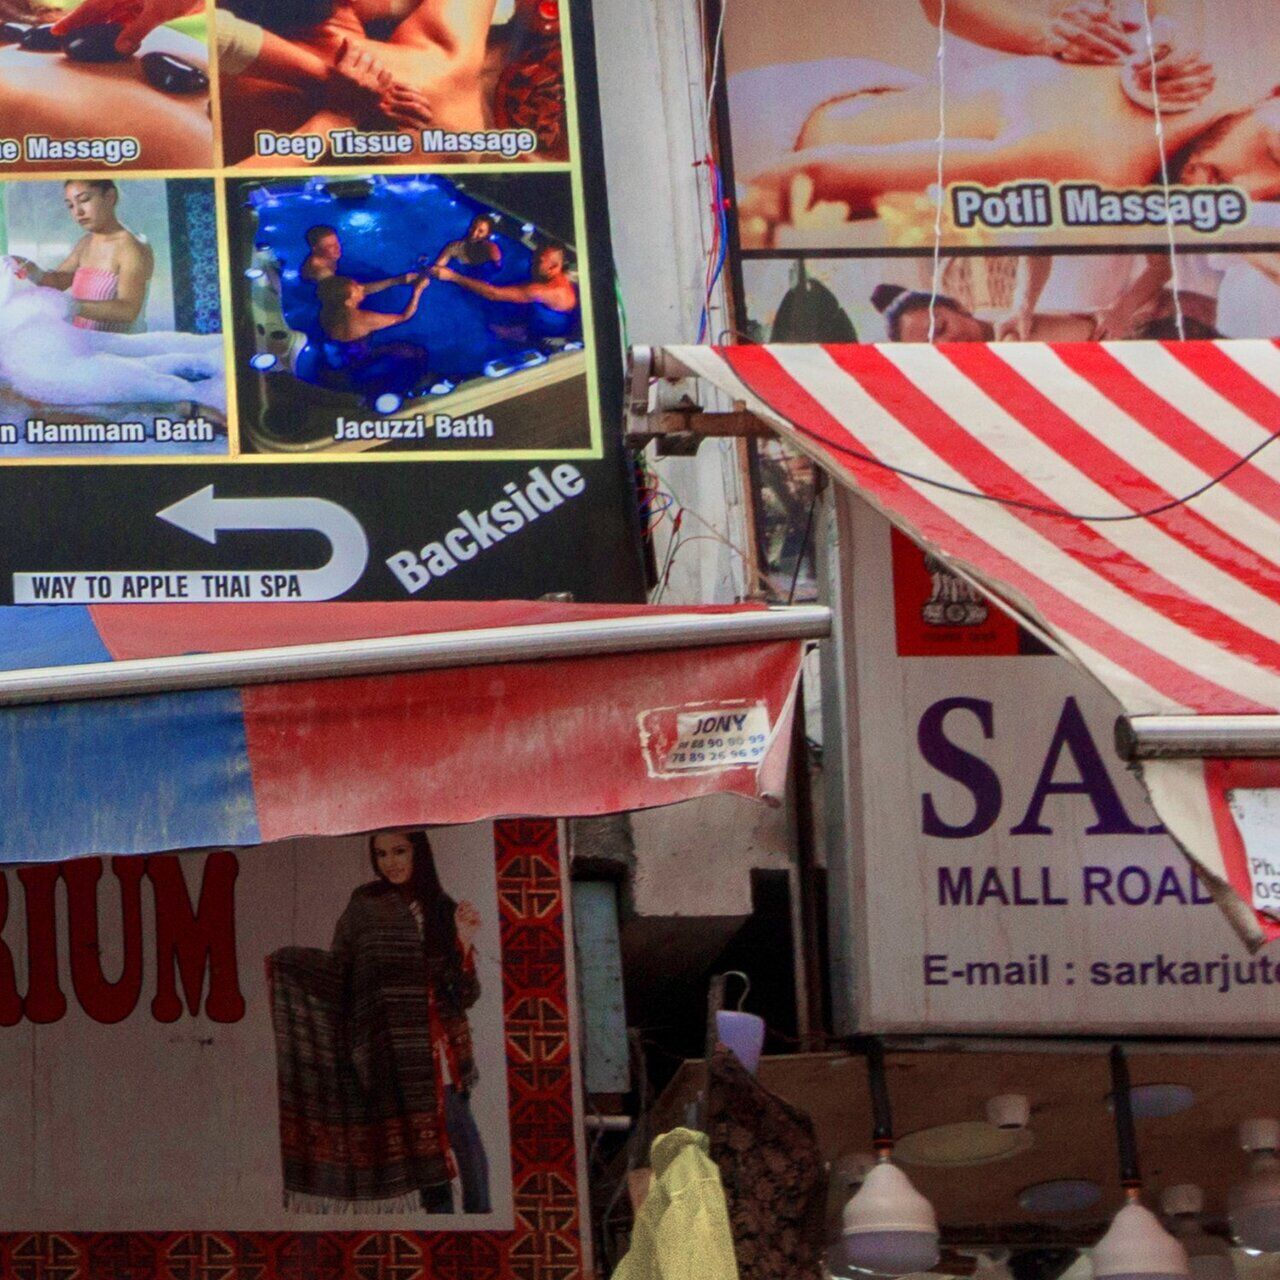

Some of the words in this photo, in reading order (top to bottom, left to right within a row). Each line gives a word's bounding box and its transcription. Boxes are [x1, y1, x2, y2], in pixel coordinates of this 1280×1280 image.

[26, 134, 139, 164] Massage
[257, 132, 323, 159] Deep
[330, 130, 413, 155] Tissue
[422, 129, 535, 157] Massage
[953, 186, 1050, 226] Potli
[1064, 187, 1243, 229] Massage
[26, 419, 146, 443] Hammam
[154, 418, 215, 442] Bath
[334, 415, 425, 440] Jacuzzi
[434, 413, 494, 438] Bath
[385, 459, 586, 594] Backside
[32, 575, 80, 599] WAY
[85, 575, 112, 599] TO
[122, 574, 189, 598] APPLE
[202, 574, 251, 598] THAI
[261, 574, 302, 598] SPA
[692, 714, 747, 735] JONY
[938, 865, 1068, 906] MALL
[923, 954, 1049, 986] E-mail
[1090, 953, 1280, 993] sarkarjut
